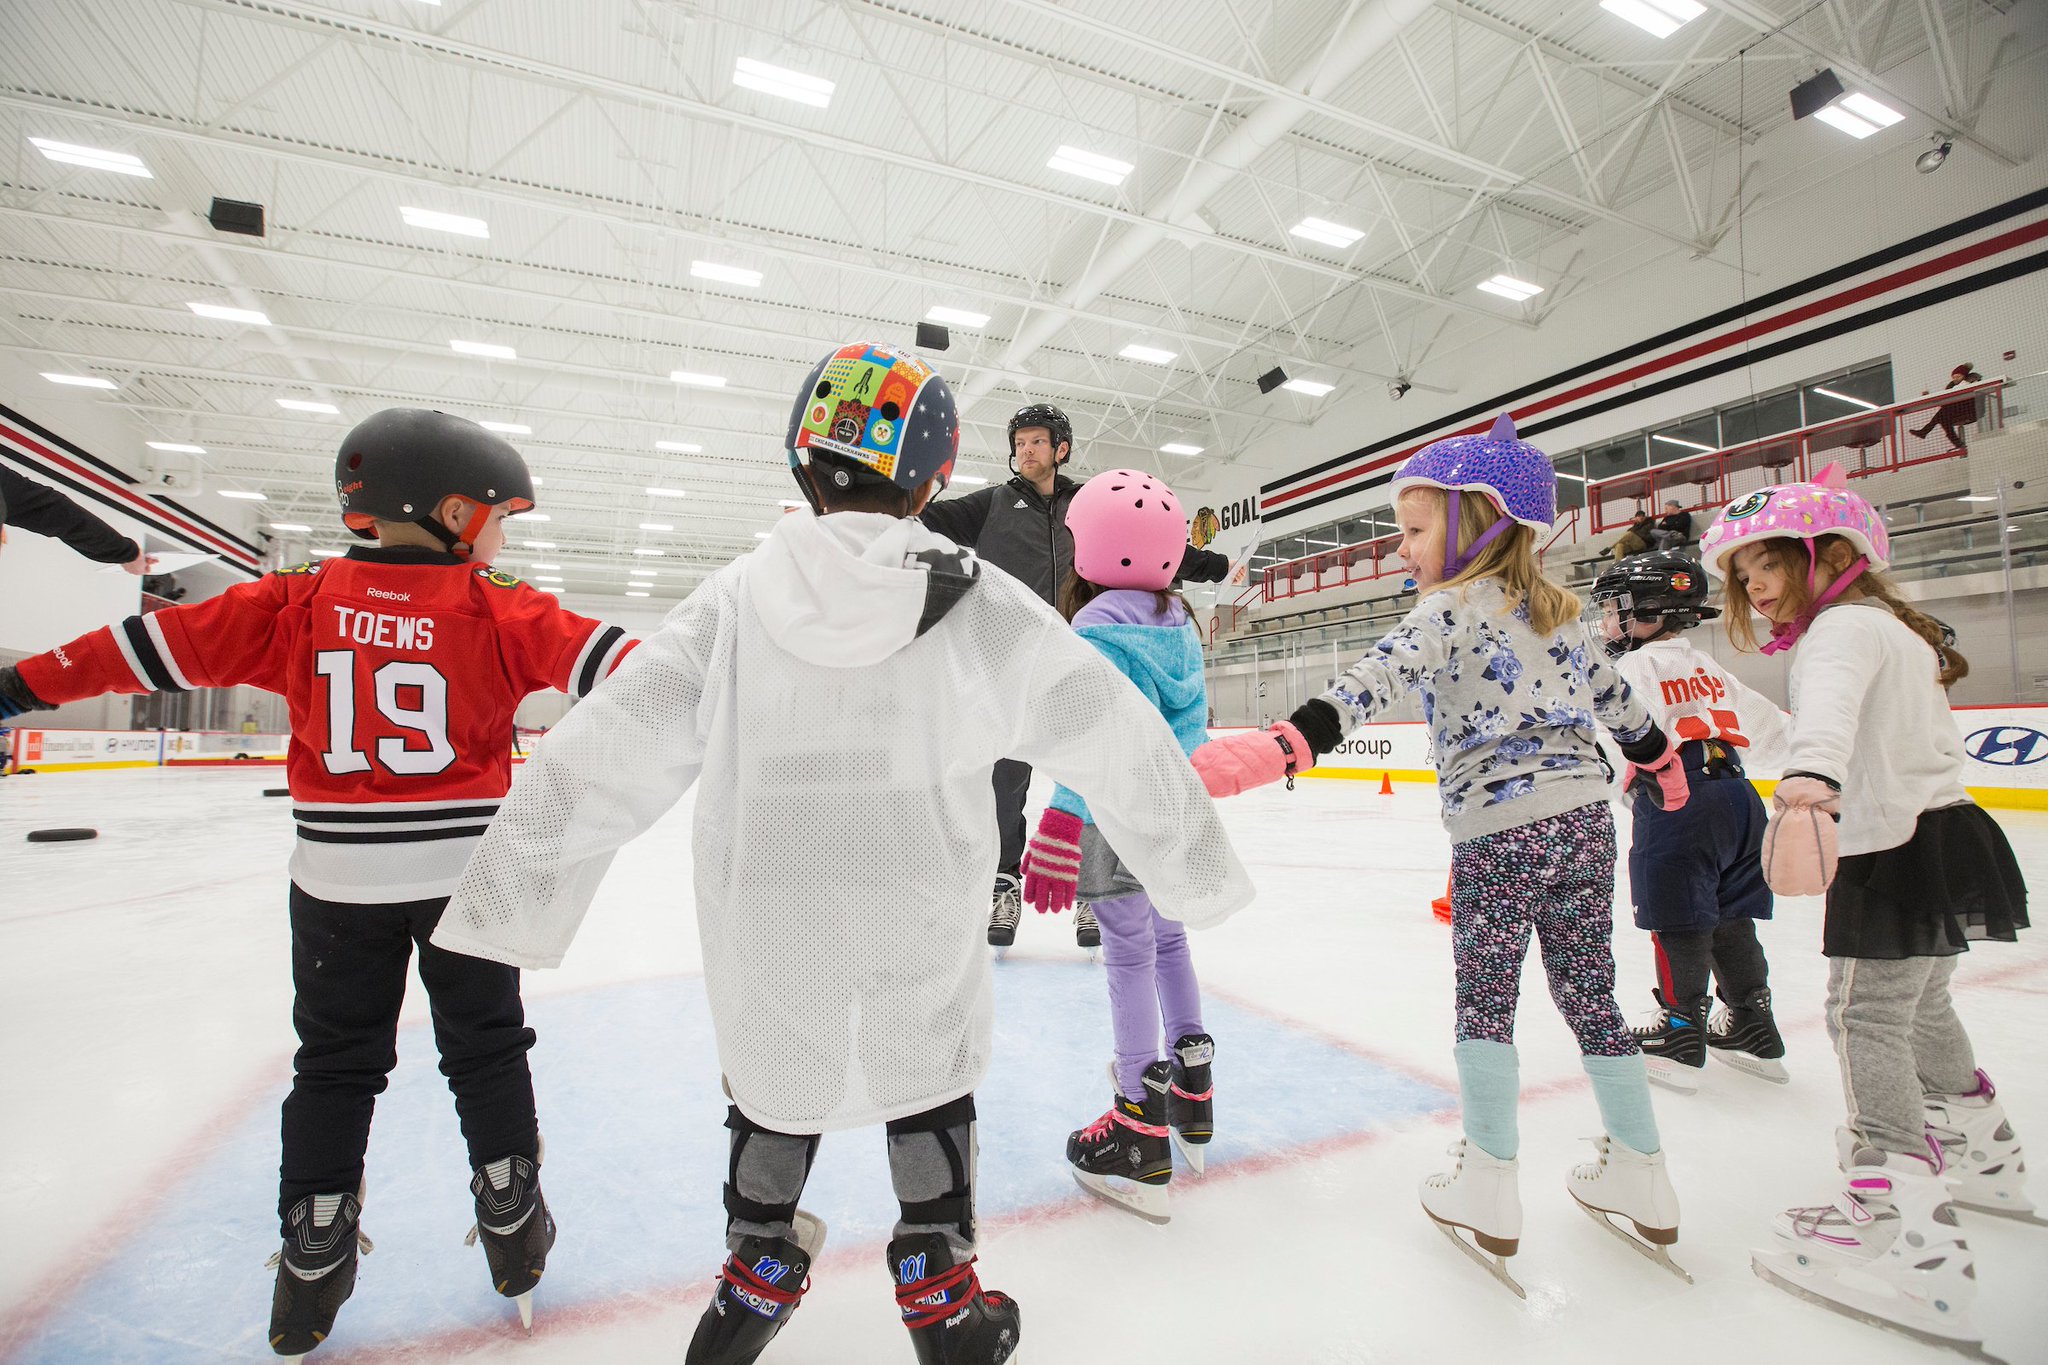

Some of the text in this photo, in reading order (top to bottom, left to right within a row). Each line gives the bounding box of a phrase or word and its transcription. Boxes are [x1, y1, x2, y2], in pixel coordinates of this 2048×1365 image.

[814, 437, 834, 448] CHICAGO
[833, 443, 870, 459] BLACKHAWKS
[1221, 495, 1260, 531] GOAL
[366, 587, 411, 602] Reebok
[333, 605, 435, 651] TOEWS
[314, 649, 458, 776] 19
[900, 1252, 926, 1285] 101
